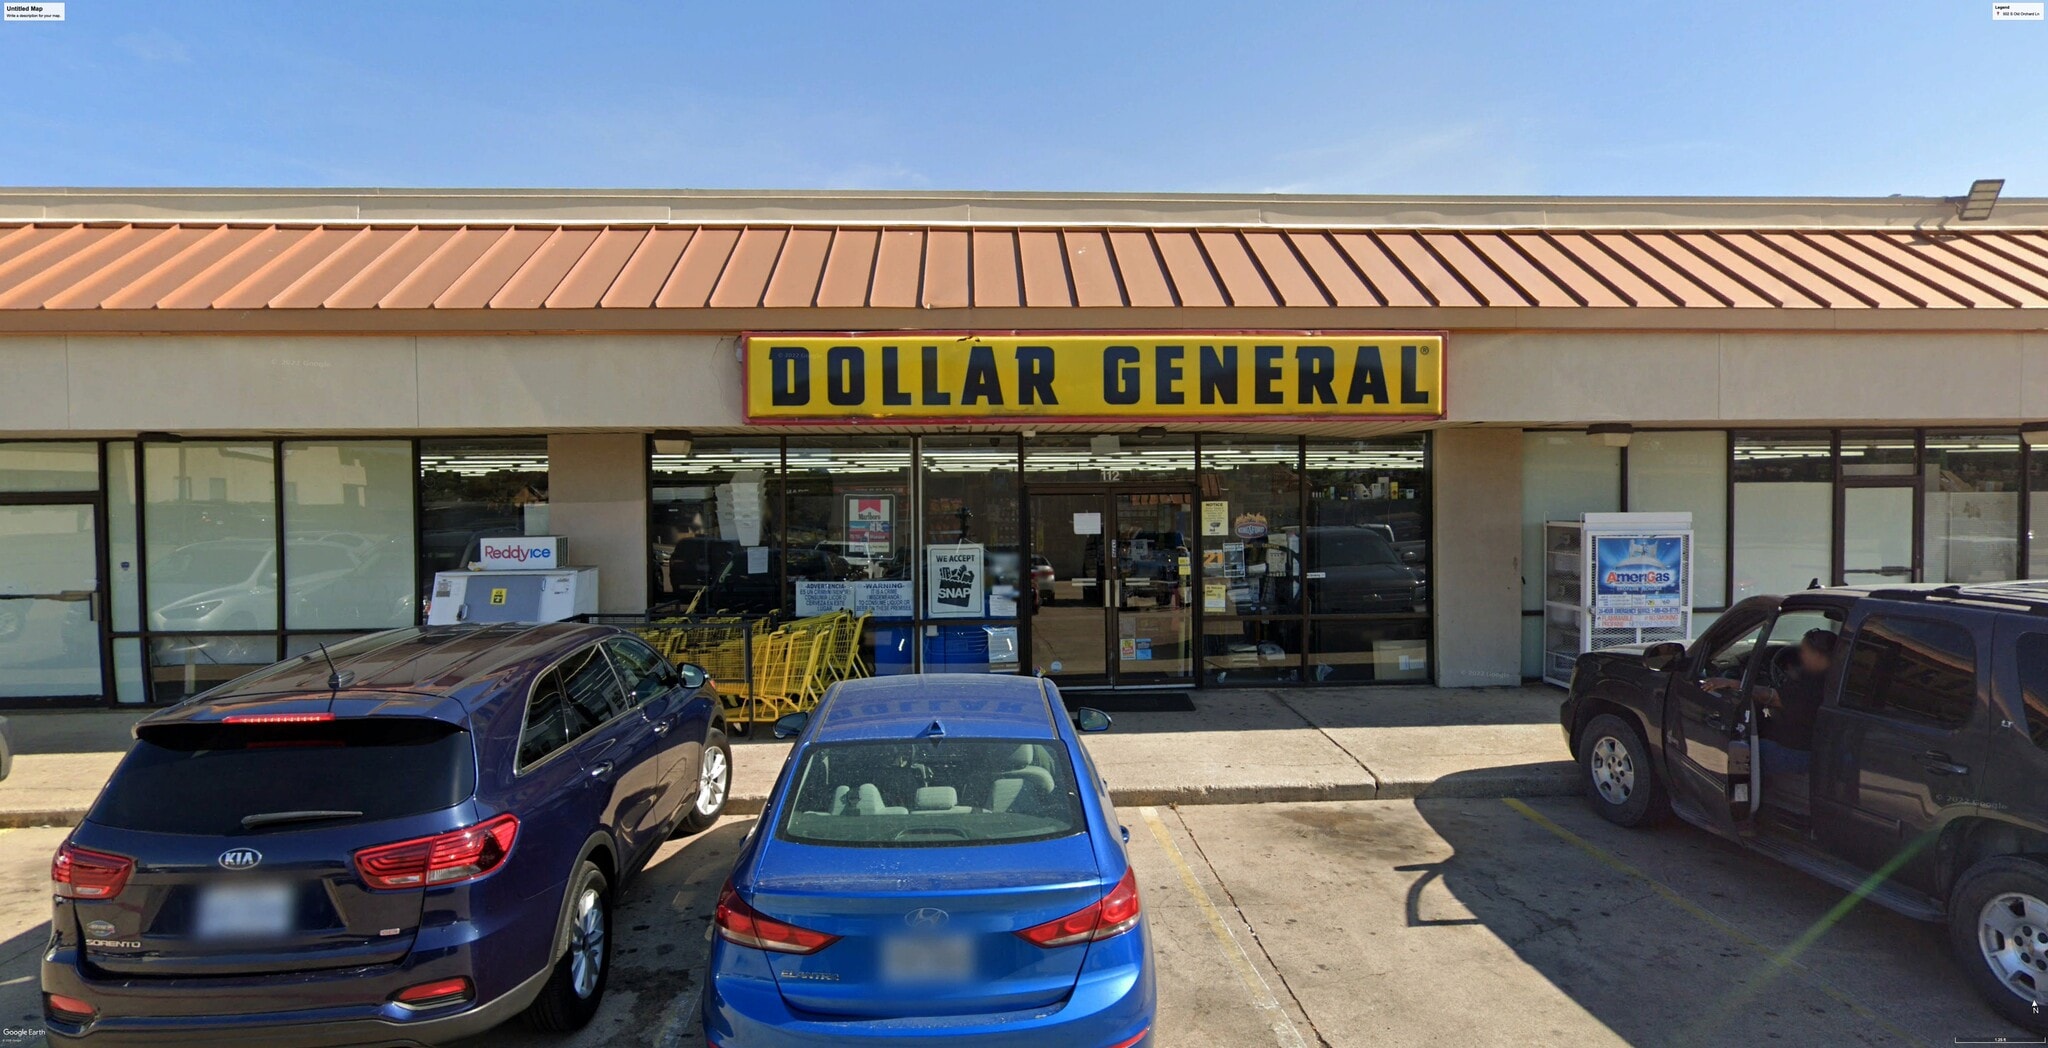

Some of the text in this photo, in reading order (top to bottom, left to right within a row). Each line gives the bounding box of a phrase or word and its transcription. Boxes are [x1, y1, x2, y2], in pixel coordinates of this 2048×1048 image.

[769, 346, 1060, 406] DOLLAR
[1101, 470, 1120, 481] 112
[858, 512, 882, 520] Marlboro
[948, 554, 975, 562] ACCEPT
[1606, 571, 1671, 585] AmeriGas
[938, 587, 971, 599] SNAP
[224, 851, 254, 866] KIA
[85, 939, 141, 948] SORENTO
[780, 970, 840, 982] ELANTRA
